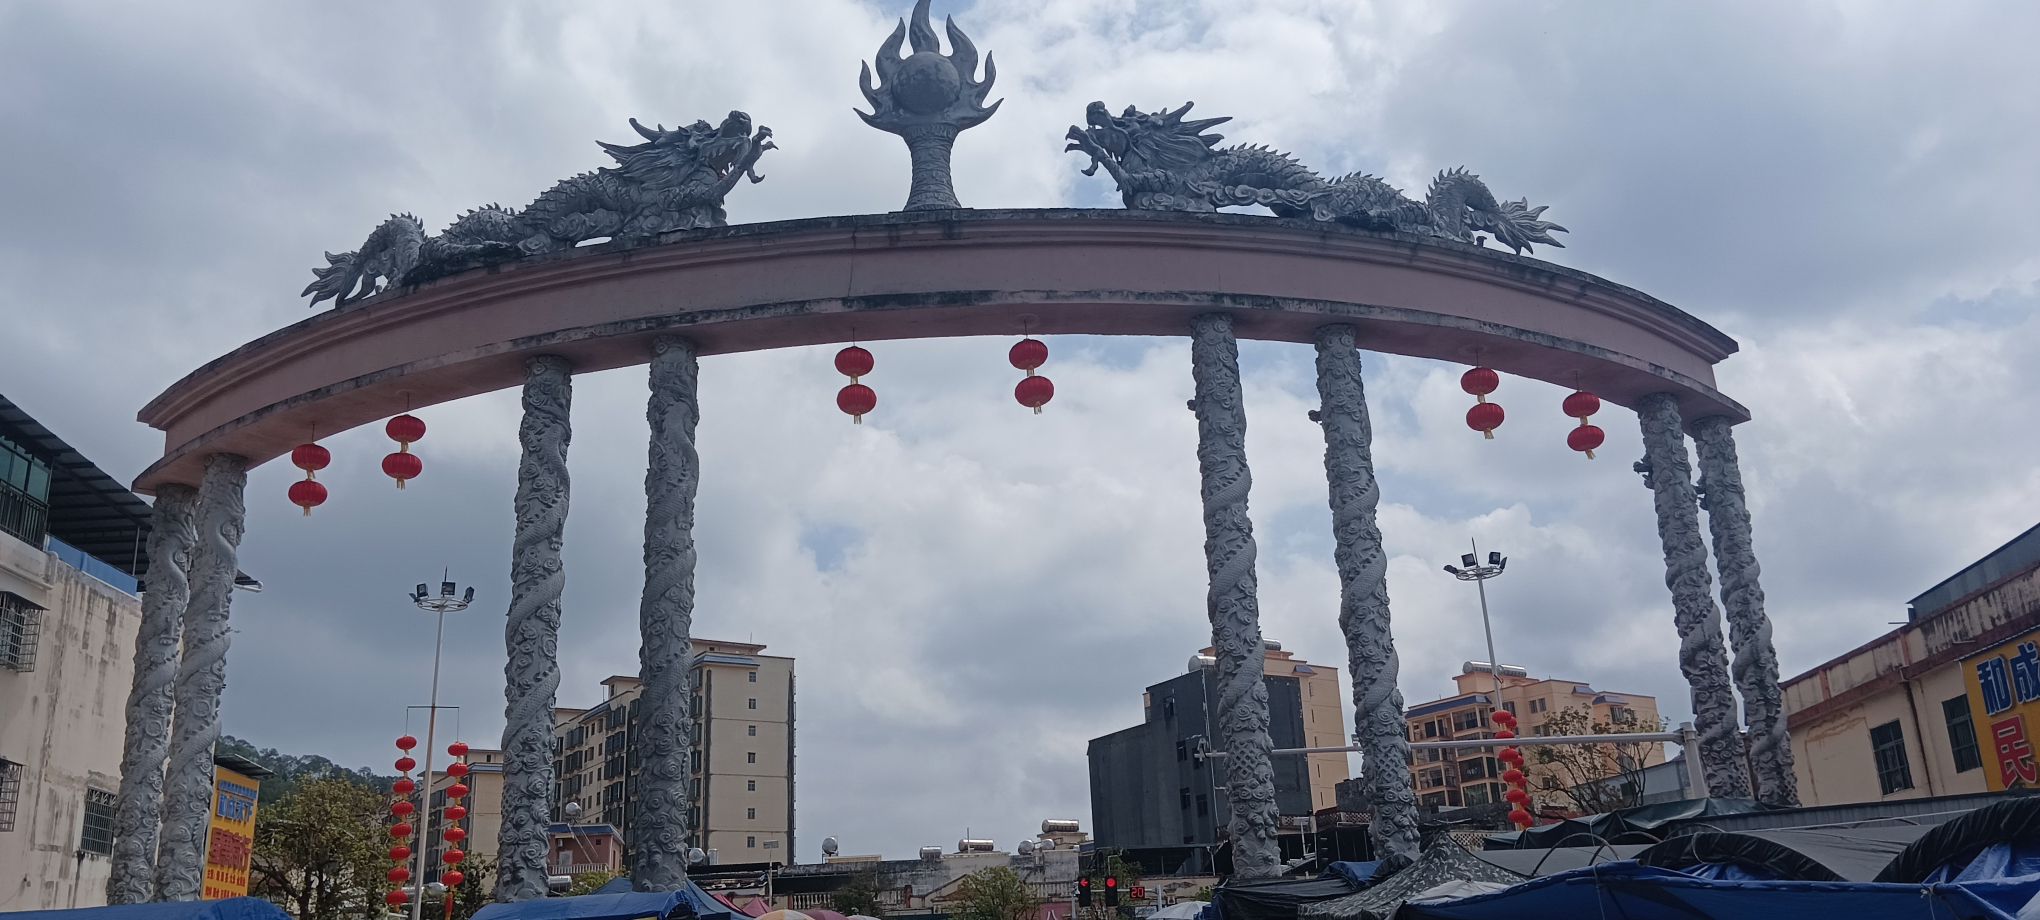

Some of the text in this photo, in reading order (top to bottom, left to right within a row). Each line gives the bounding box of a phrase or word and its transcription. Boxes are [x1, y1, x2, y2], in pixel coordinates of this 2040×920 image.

[1976, 641, 2040, 716] 和成
[1991, 714, 2037, 790] 民
[1131, 887, 1144, 898] 20
